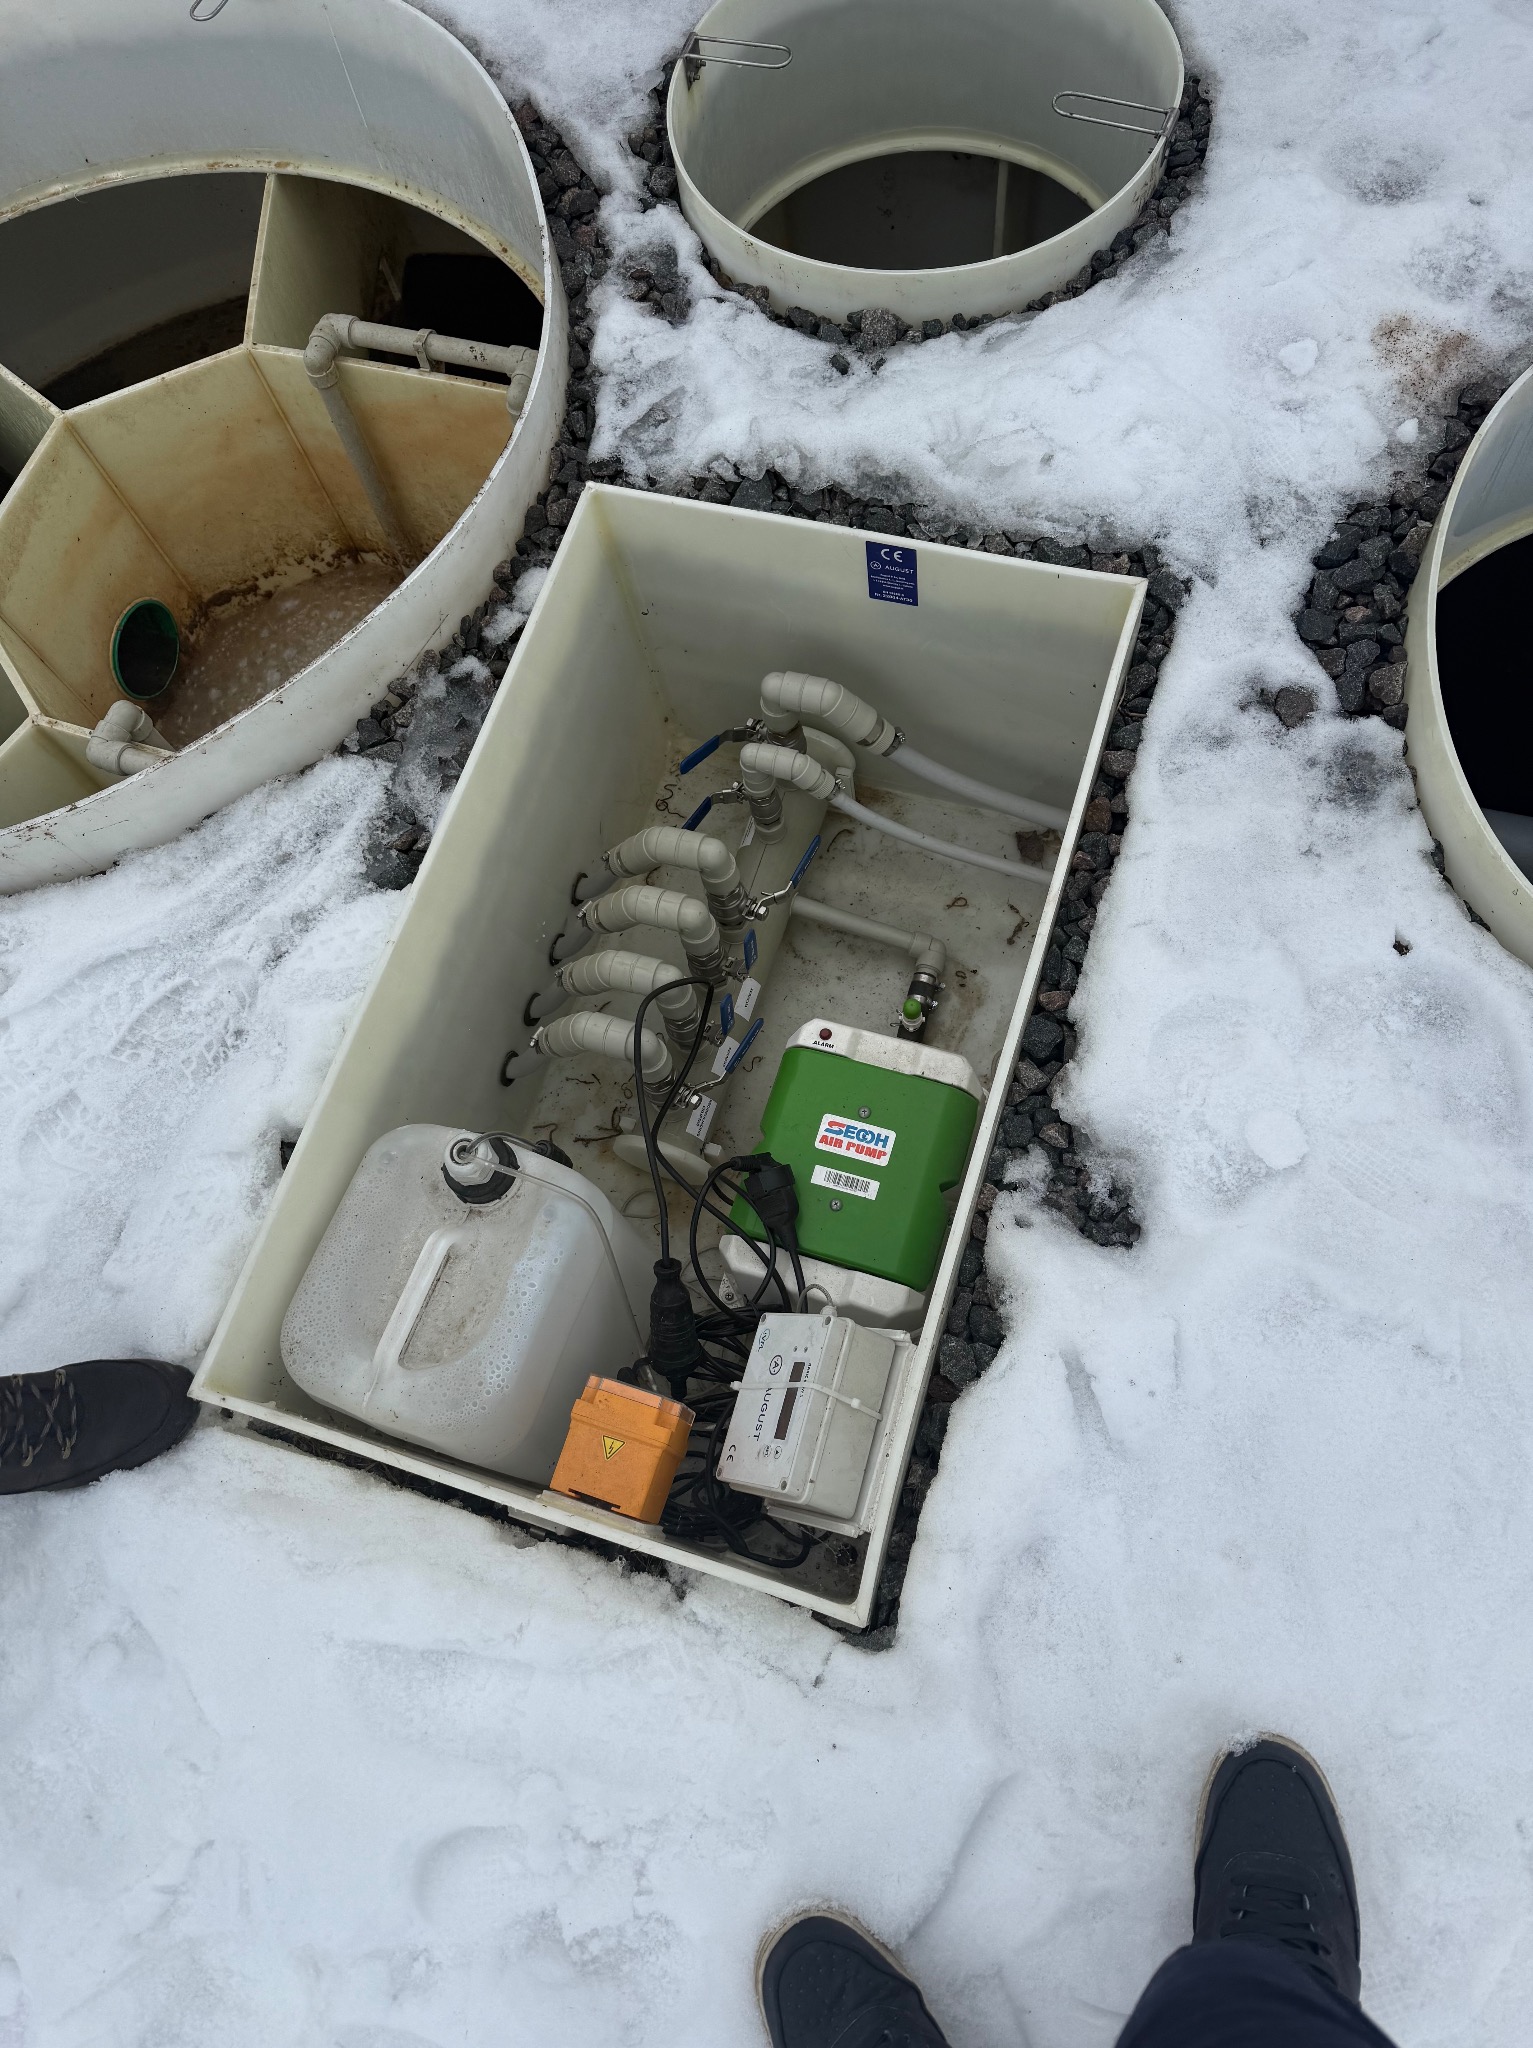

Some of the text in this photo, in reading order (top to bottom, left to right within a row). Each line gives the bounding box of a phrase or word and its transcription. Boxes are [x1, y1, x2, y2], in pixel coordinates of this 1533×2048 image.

[880, 548, 903, 563] CE
[884, 565, 914, 574] AUGUST
[812, 1040, 835, 1049] ALARM
[819, 1134, 888, 1160] AIR PUMP
